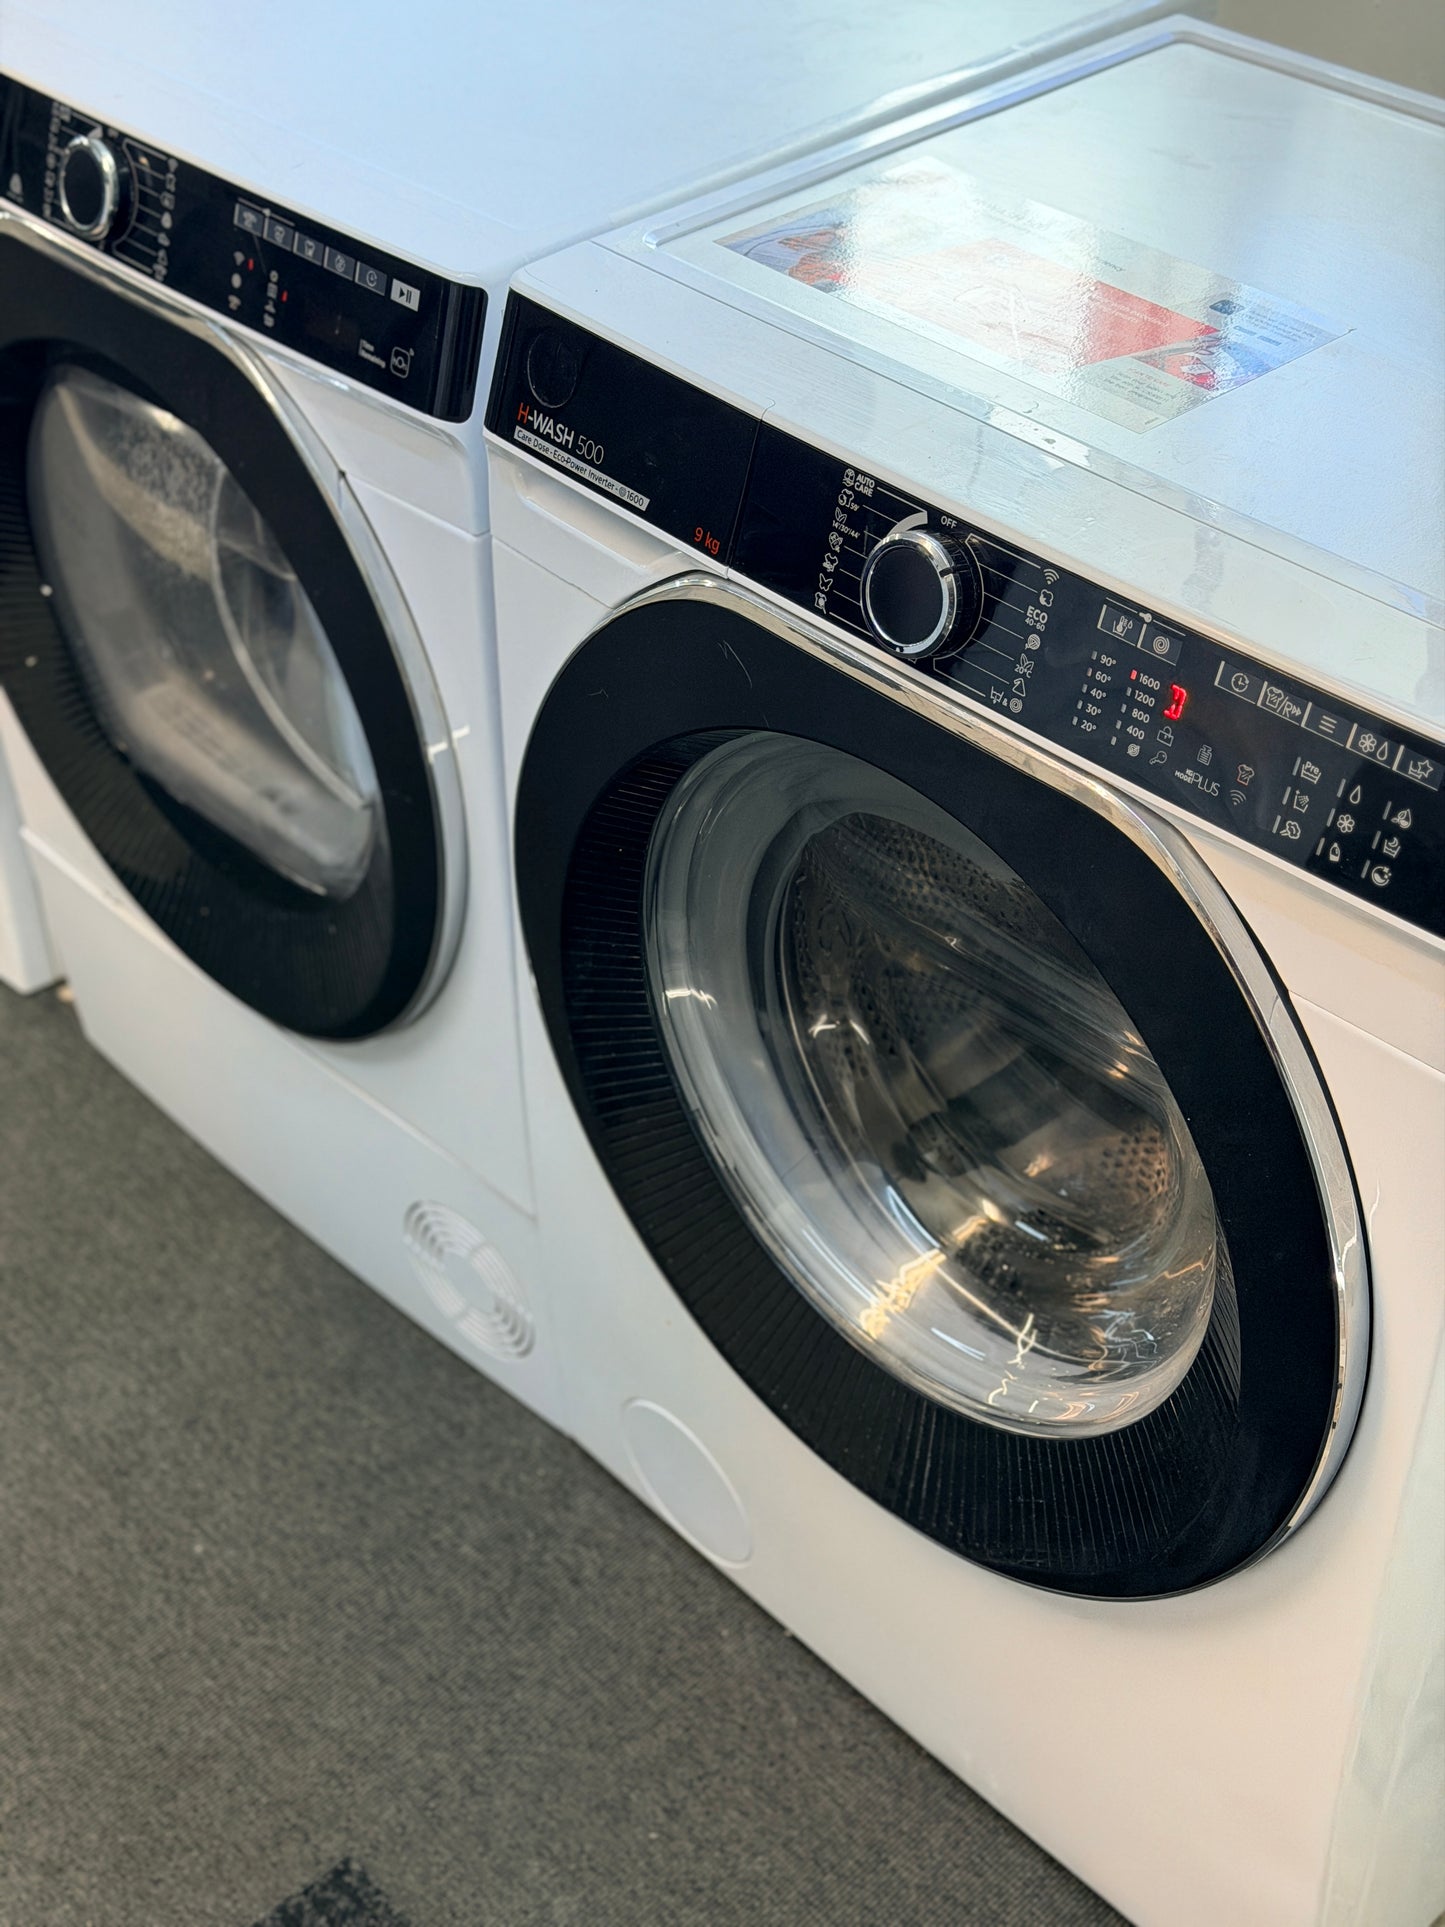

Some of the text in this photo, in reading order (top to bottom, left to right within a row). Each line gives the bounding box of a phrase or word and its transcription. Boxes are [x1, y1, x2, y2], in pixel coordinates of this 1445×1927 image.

[517, 402, 605, 464] H-WASH 500
[517, 430, 532, 444] Care
[533, 439, 550, 454] Dose
[588, 469, 615, 491] Inverter
[856, 473, 875, 488] AUTO
[854, 482, 874, 497] CARE
[940, 515, 958, 529] OFF
[694, 527, 720, 555] 9 kg
[1026, 605, 1048, 624] ECO
[1025, 617, 1046, 632] 40-60
[1100, 654, 1117, 667] 90°
[1014, 664, 1033, 678] 20°C
[1095, 671, 1112, 683] 60°
[1139, 673, 1161, 691] 1600
[1090, 687, 1107, 700] 40°
[1134, 690, 1156, 707] 1200
[1085, 703, 1102, 716] 30°
[1131, 708, 1150, 723] 800
[1080, 720, 1097, 732] 20°
[1126, 725, 1145, 740] 400
[1304, 761, 1320, 775] Pre
[1192, 772, 1221, 797] PLUS
